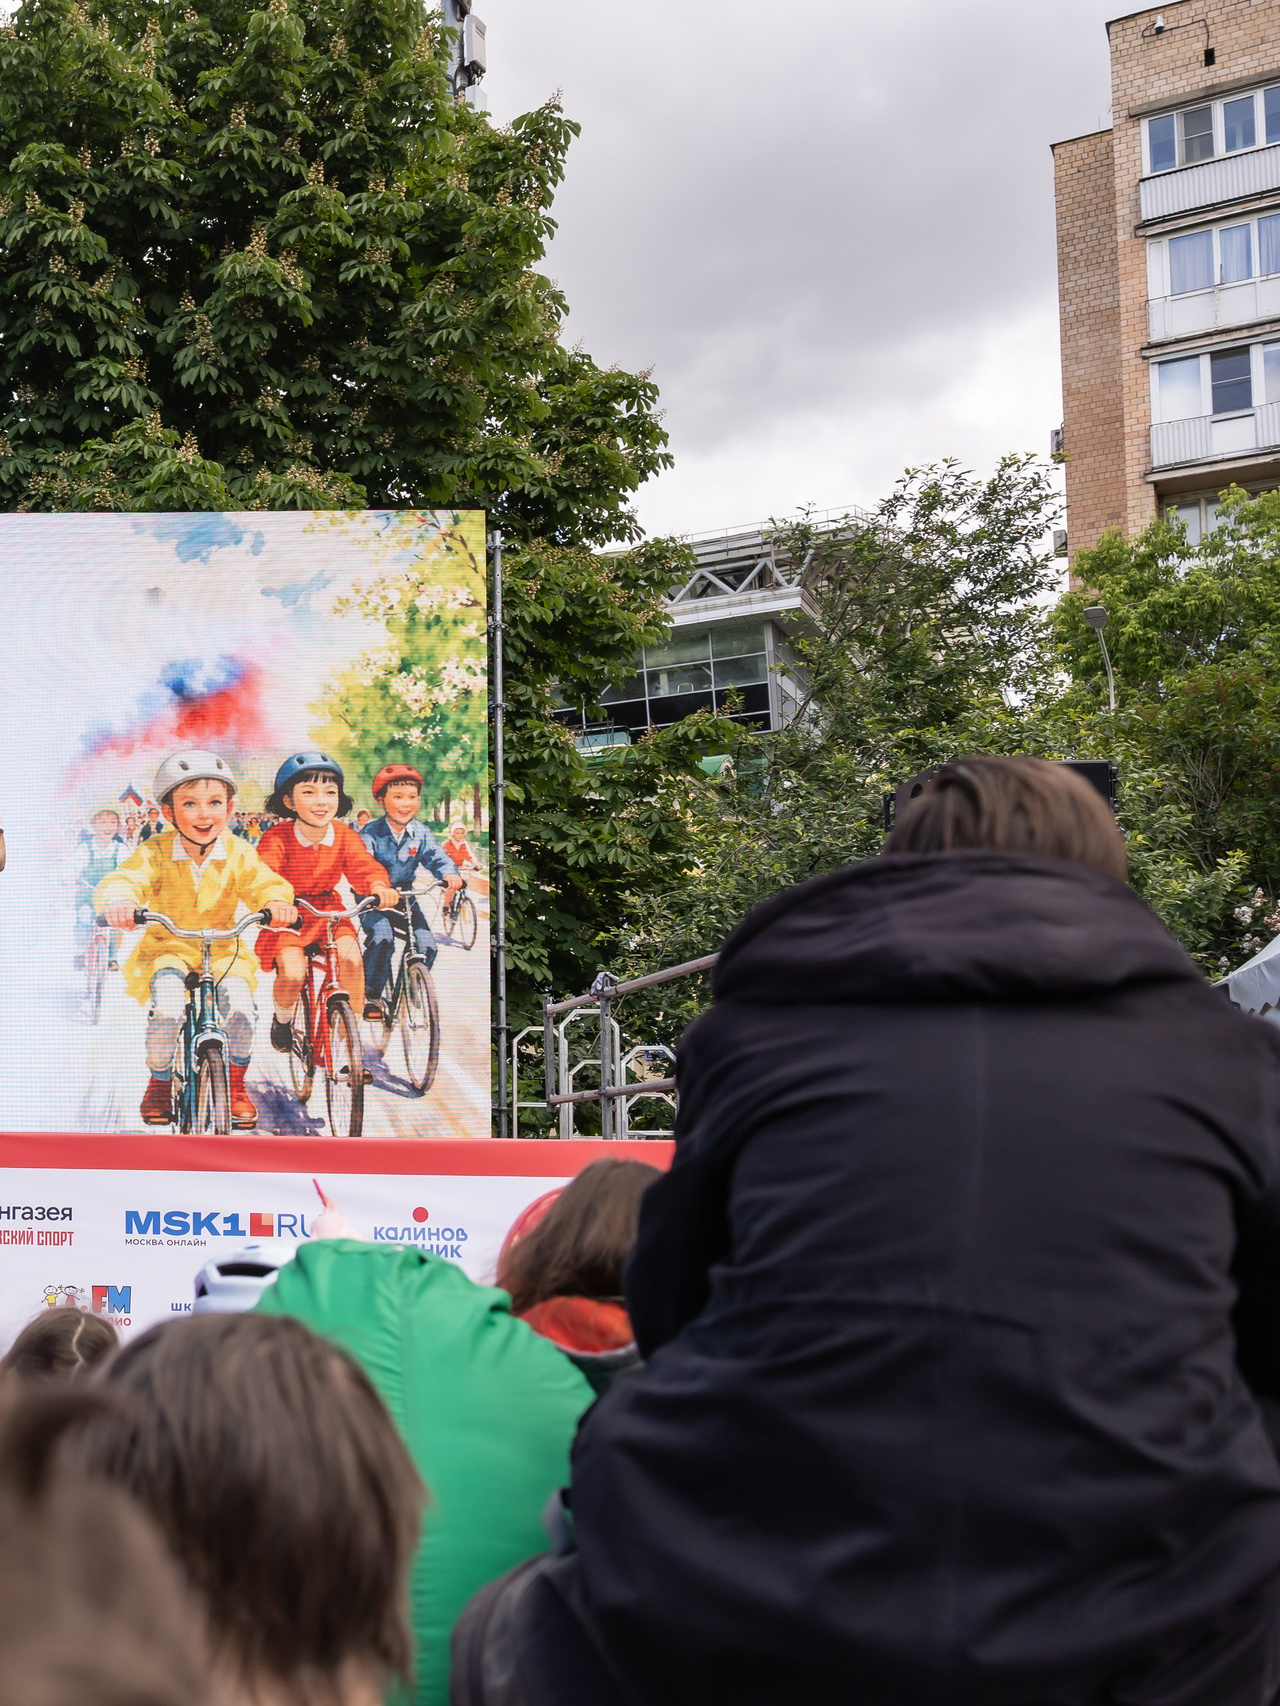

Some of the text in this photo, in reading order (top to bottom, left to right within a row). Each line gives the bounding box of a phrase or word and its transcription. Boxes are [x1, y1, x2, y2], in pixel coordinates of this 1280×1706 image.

[125, 1210, 246, 1237] MSK1
[37, 1231, 74, 1246] СПОРТ
[125, 1238, 207, 1247] МОСКВА ОНЛАЙН
